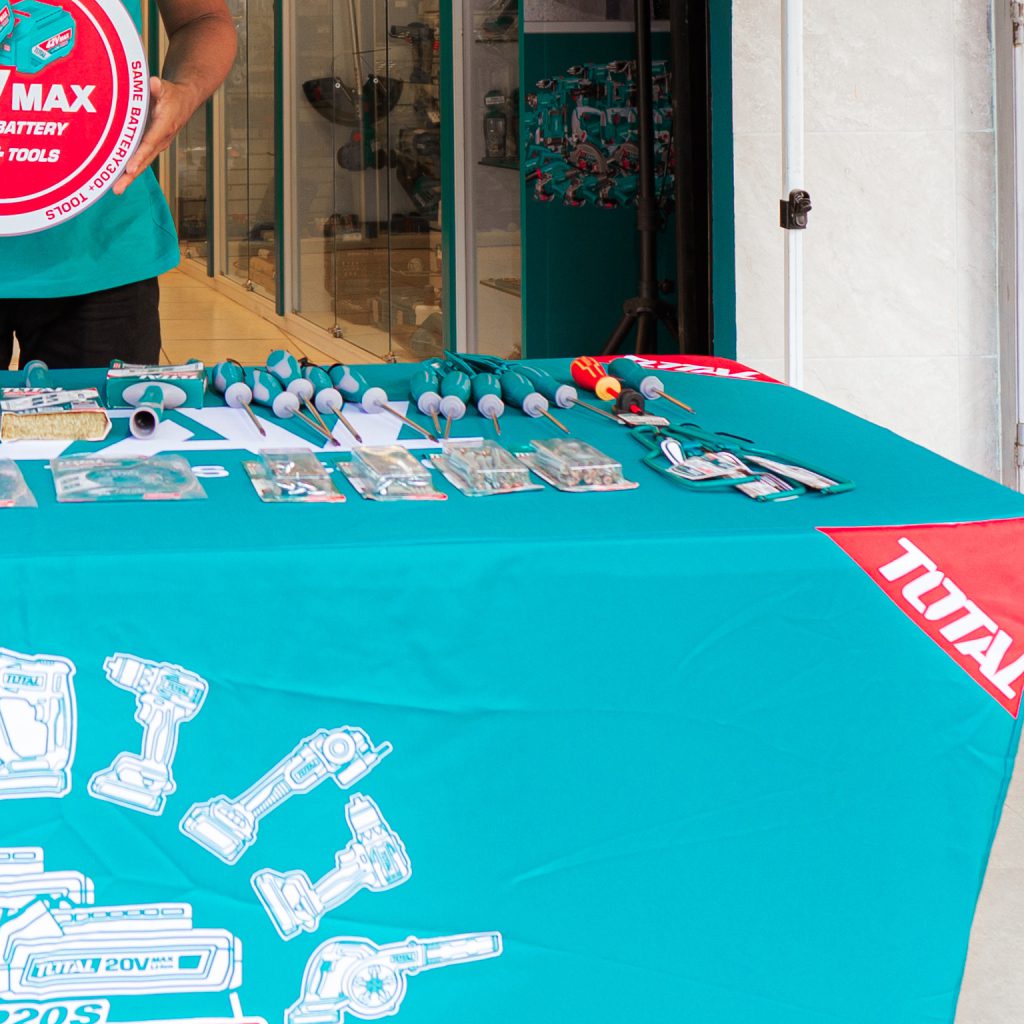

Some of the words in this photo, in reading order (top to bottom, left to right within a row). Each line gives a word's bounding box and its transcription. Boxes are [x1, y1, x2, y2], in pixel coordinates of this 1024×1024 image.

[131, 60, 144, 102] SAME
[11, 83, 97, 113] MAX
[114, 107, 143, 167] BATTERY
[8, 147, 61, 163] TOOLS
[88, 162, 118, 193] 300+
[45, 193, 88, 221] TOOLS
[878, 537, 1024, 700] TOTAL
[35, 960, 96, 976] TOTAL
[105, 957, 150, 971] 20V
